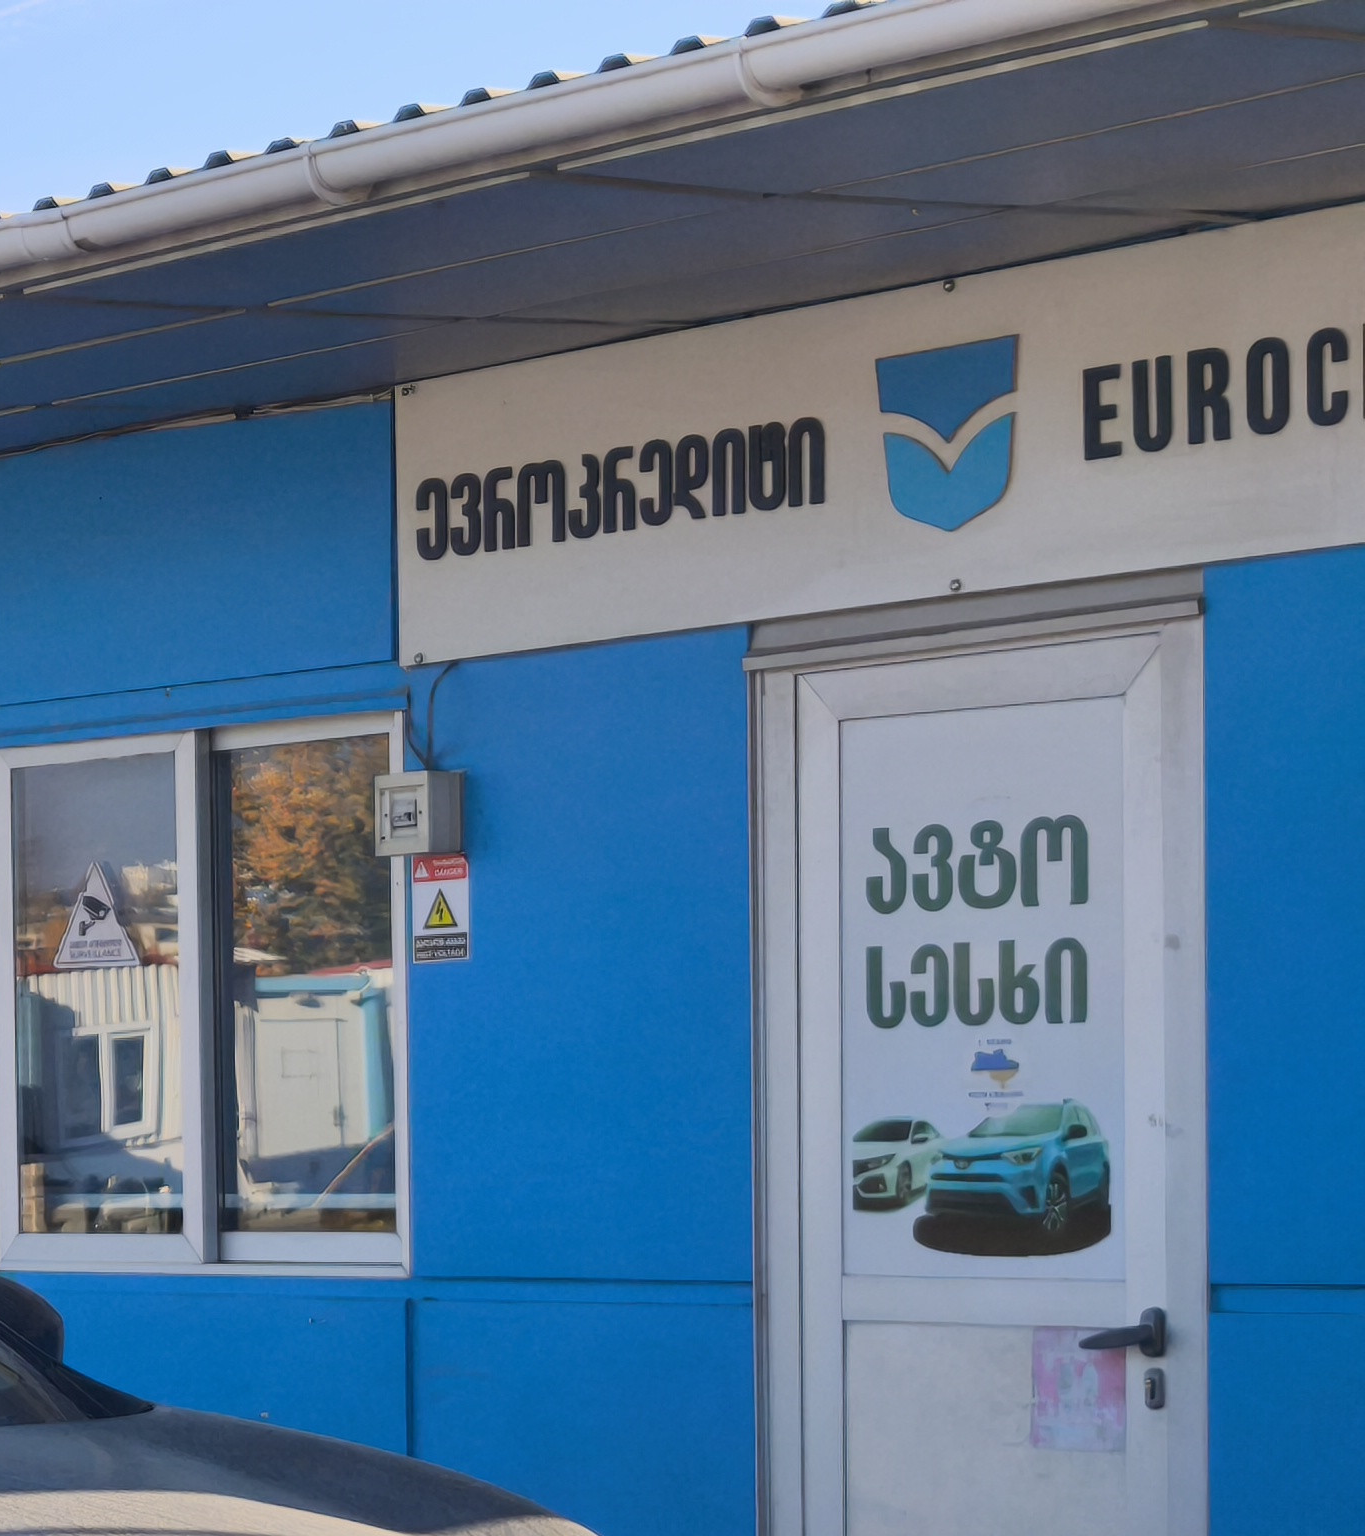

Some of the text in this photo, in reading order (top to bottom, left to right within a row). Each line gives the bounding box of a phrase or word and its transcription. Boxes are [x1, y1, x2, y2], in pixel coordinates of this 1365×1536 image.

[1082, 323, 1365, 461] EUROC
[415, 416, 826, 561] ევროკრედიტი
[866, 814, 1089, 914] ავტო
[866, 937, 1088, 1029] სესხი
